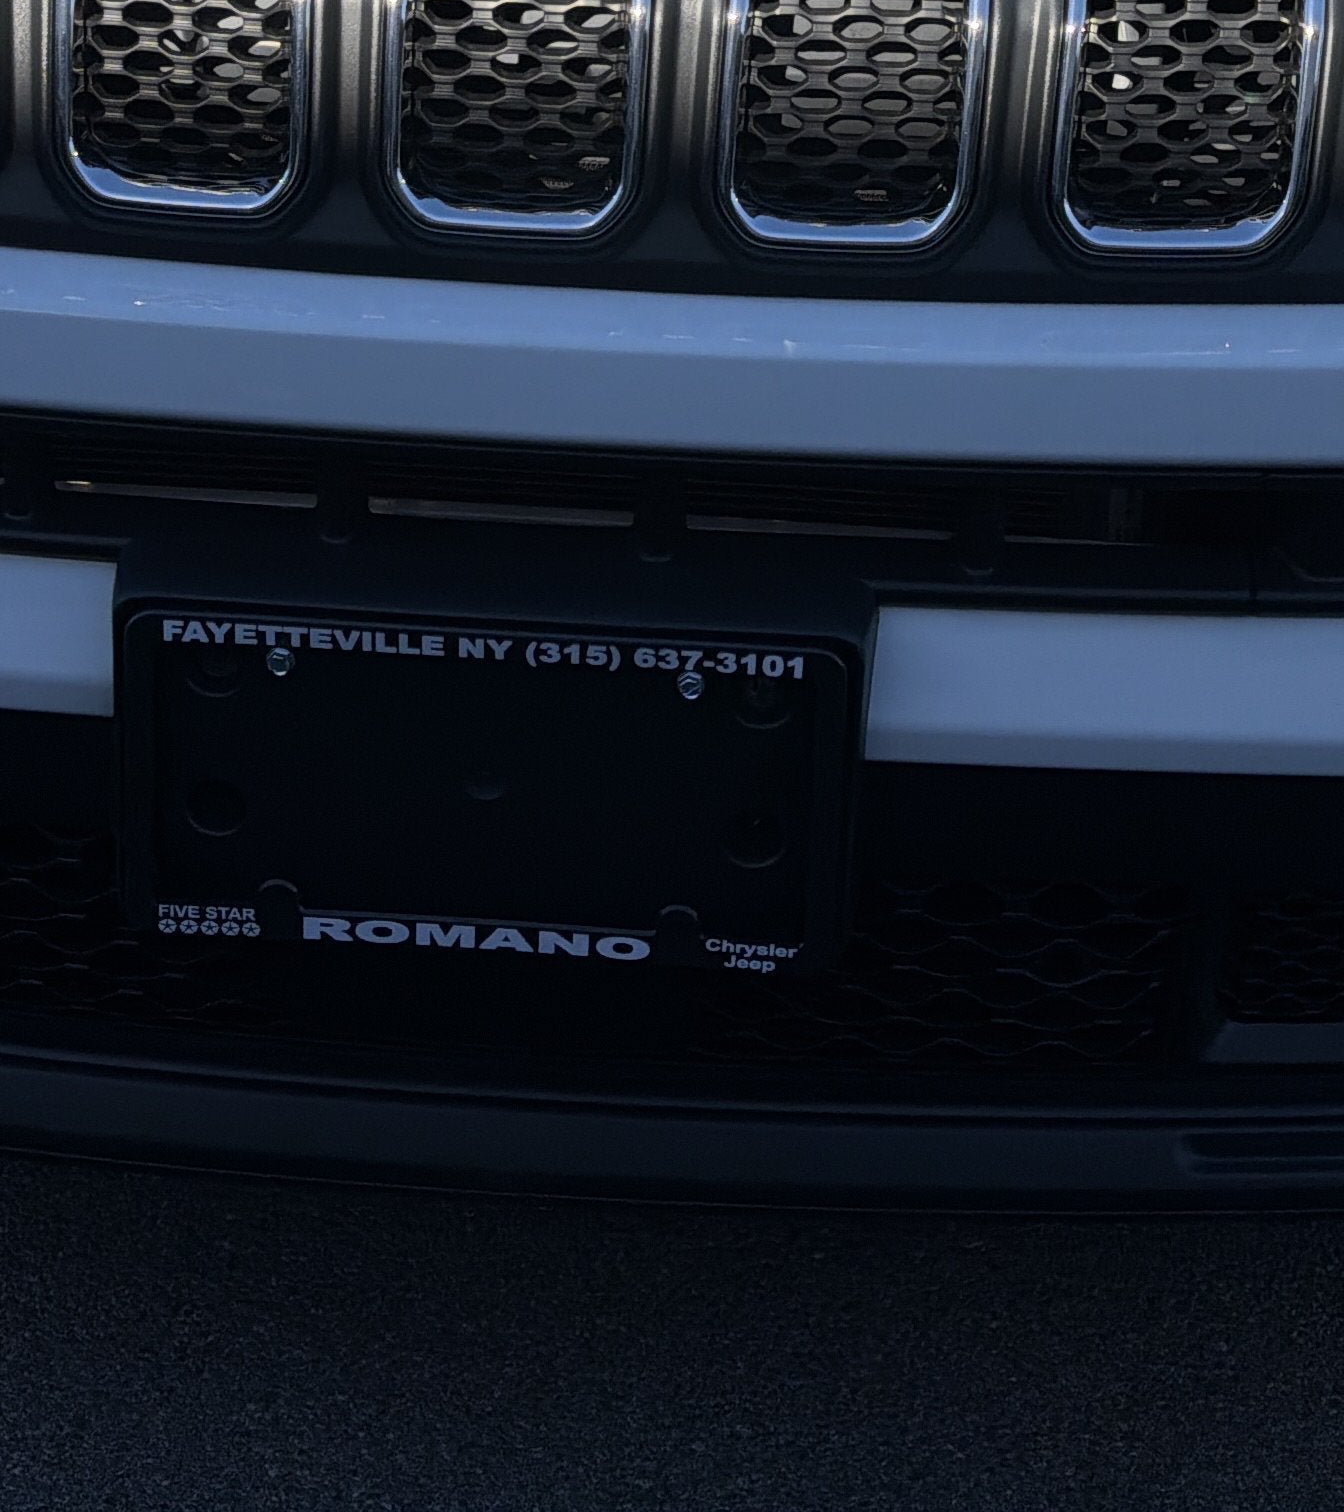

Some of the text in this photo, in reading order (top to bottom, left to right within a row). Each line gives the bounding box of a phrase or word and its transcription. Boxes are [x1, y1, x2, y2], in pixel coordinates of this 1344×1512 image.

[162, 619, 805, 681] FAYETTEVILLE NY (315) 637-3101
[158, 903, 256, 926] FIVE STAR
[302, 916, 651, 961] ROMANO
[705, 937, 799, 959] Chrysler
[723, 954, 776, 974] Jeep
